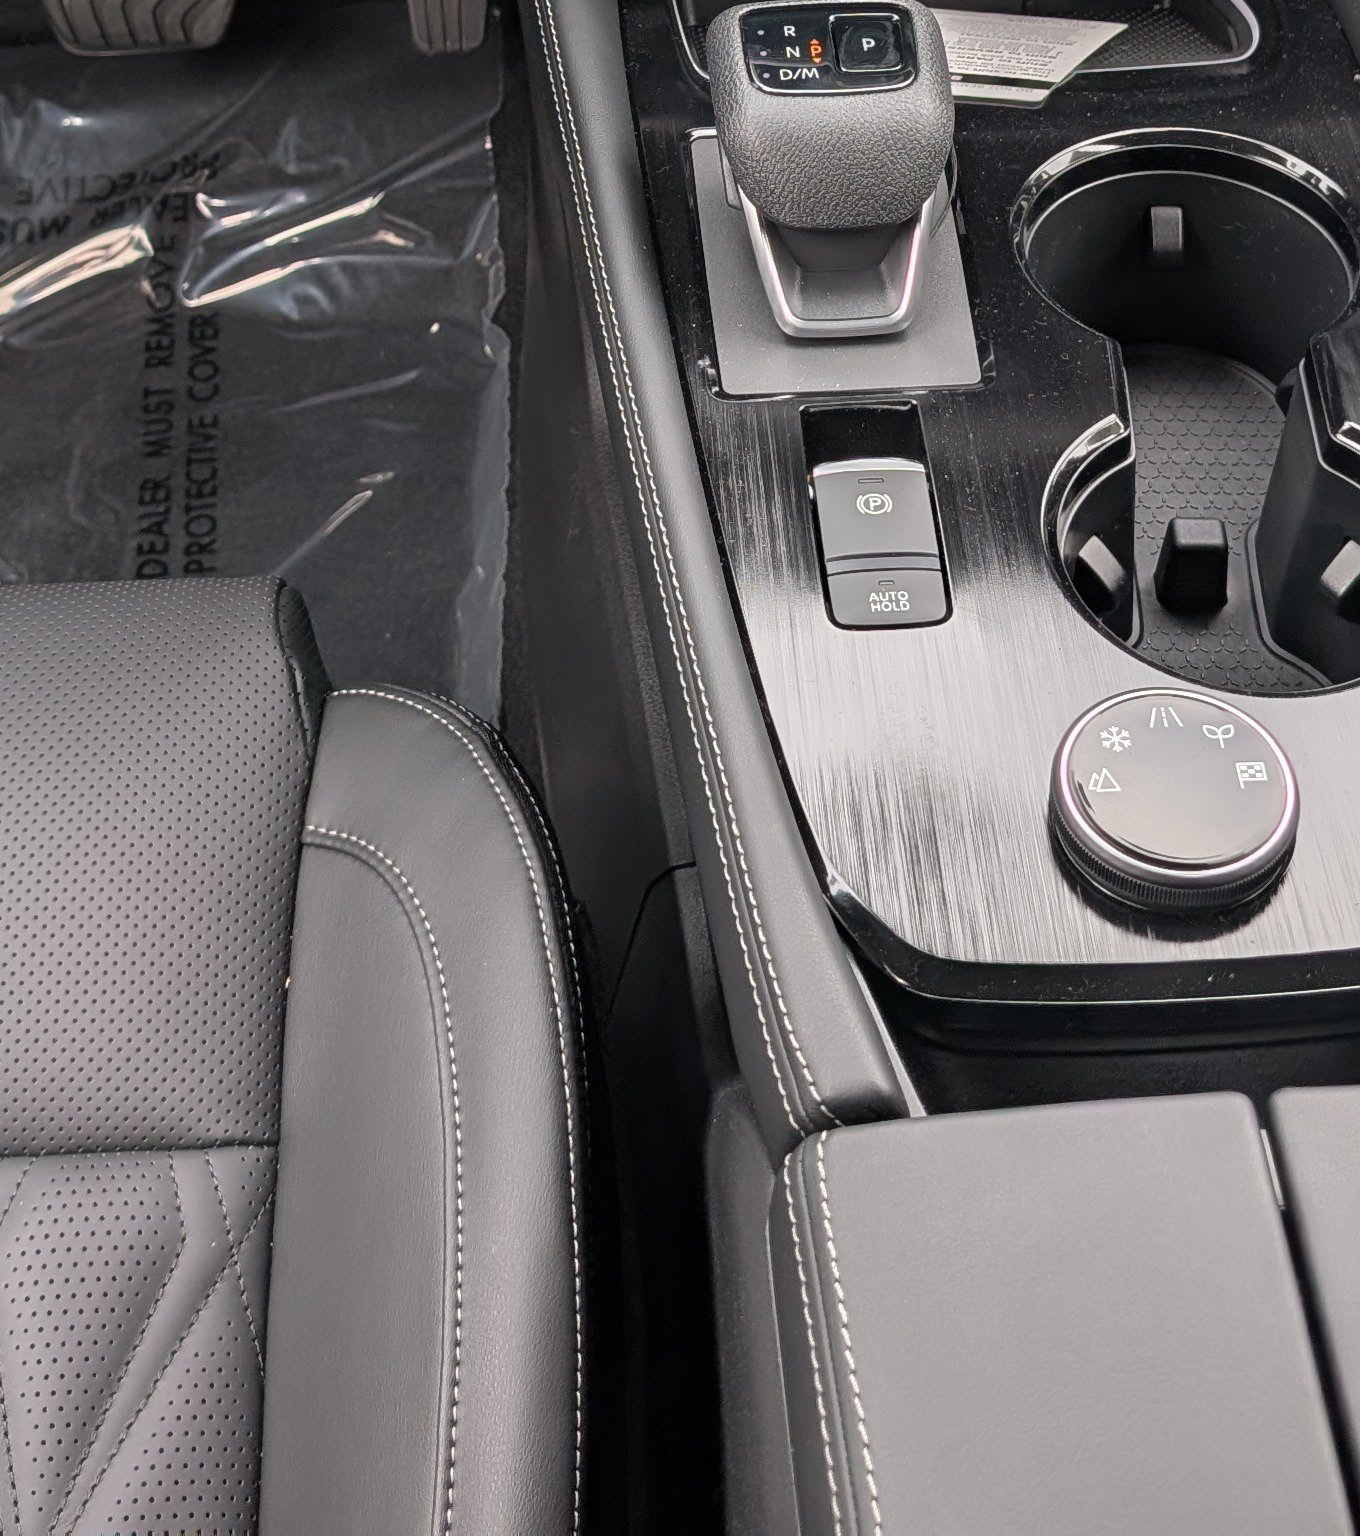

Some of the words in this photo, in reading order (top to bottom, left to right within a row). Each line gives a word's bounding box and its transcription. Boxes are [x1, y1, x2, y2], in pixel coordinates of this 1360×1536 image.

[783, 26, 797, 38] R
[786, 46, 800, 58] N
[810, 45, 821, 58] P
[862, 38, 876, 52] P
[779, 67, 820, 81] D/M
[185, 310, 221, 403] COVER
[140, 386, 175, 459] MUST
[181, 414, 220, 575] PROTECTIVE
[134, 477, 172, 581] DEALER
[868, 590, 909, 603] AUTO
[870, 599, 910, 612] HOLD
